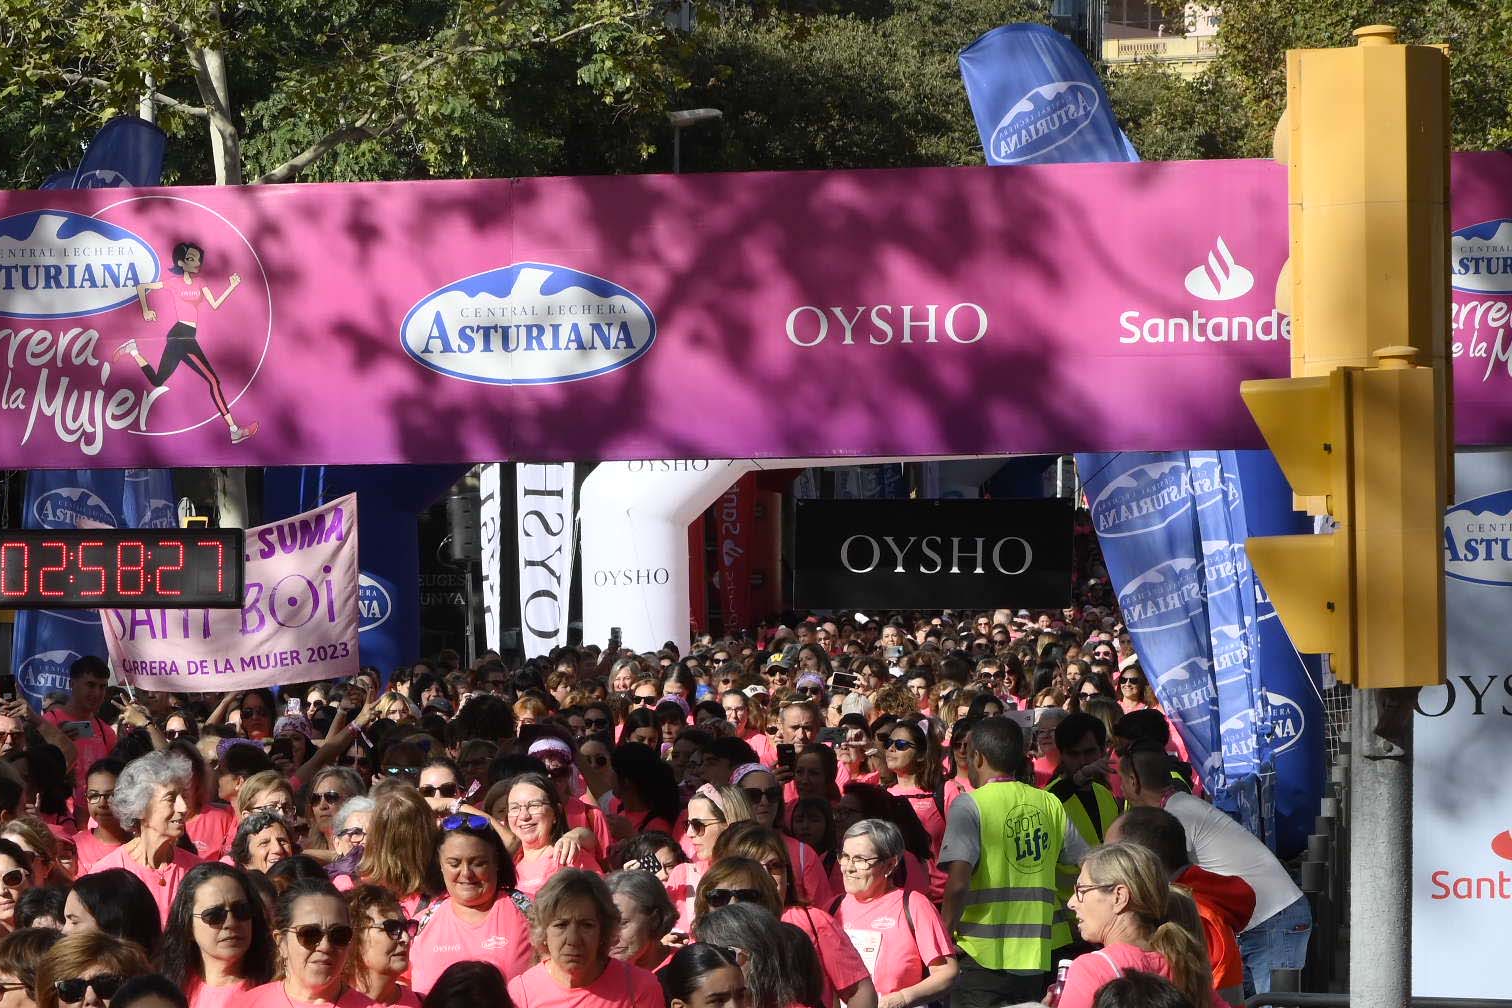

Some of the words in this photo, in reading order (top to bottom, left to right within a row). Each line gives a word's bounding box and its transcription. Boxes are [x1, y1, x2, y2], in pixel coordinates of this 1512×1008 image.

[63, 246, 135, 257] LECHERA
[460, 304, 539, 318] CENTRAL
[546, 303, 628, 315] LECHERA
[785, 302, 989, 346] OYSHO
[1119, 309, 1291, 343] Santande
[421, 310, 637, 354] ASTURIANA
[1469, 330, 1488, 358] la
[1, 369, 26, 410] la
[20, 361, 170, 456] Mujer
[258, 507, 345, 560] SUMA
[0, 542, 224, 596] 02:58:27
[840, 535, 1034, 576] OYSHO
[594, 567, 670, 587] OYSHO
[122, 657, 179, 677] CARRERA
[187, 659, 210, 676] DE
[214, 658, 236, 674] LA
[241, 650, 303, 672] MUJER
[307, 643, 350, 663] 2023
[1014, 827, 1049, 862] Life
